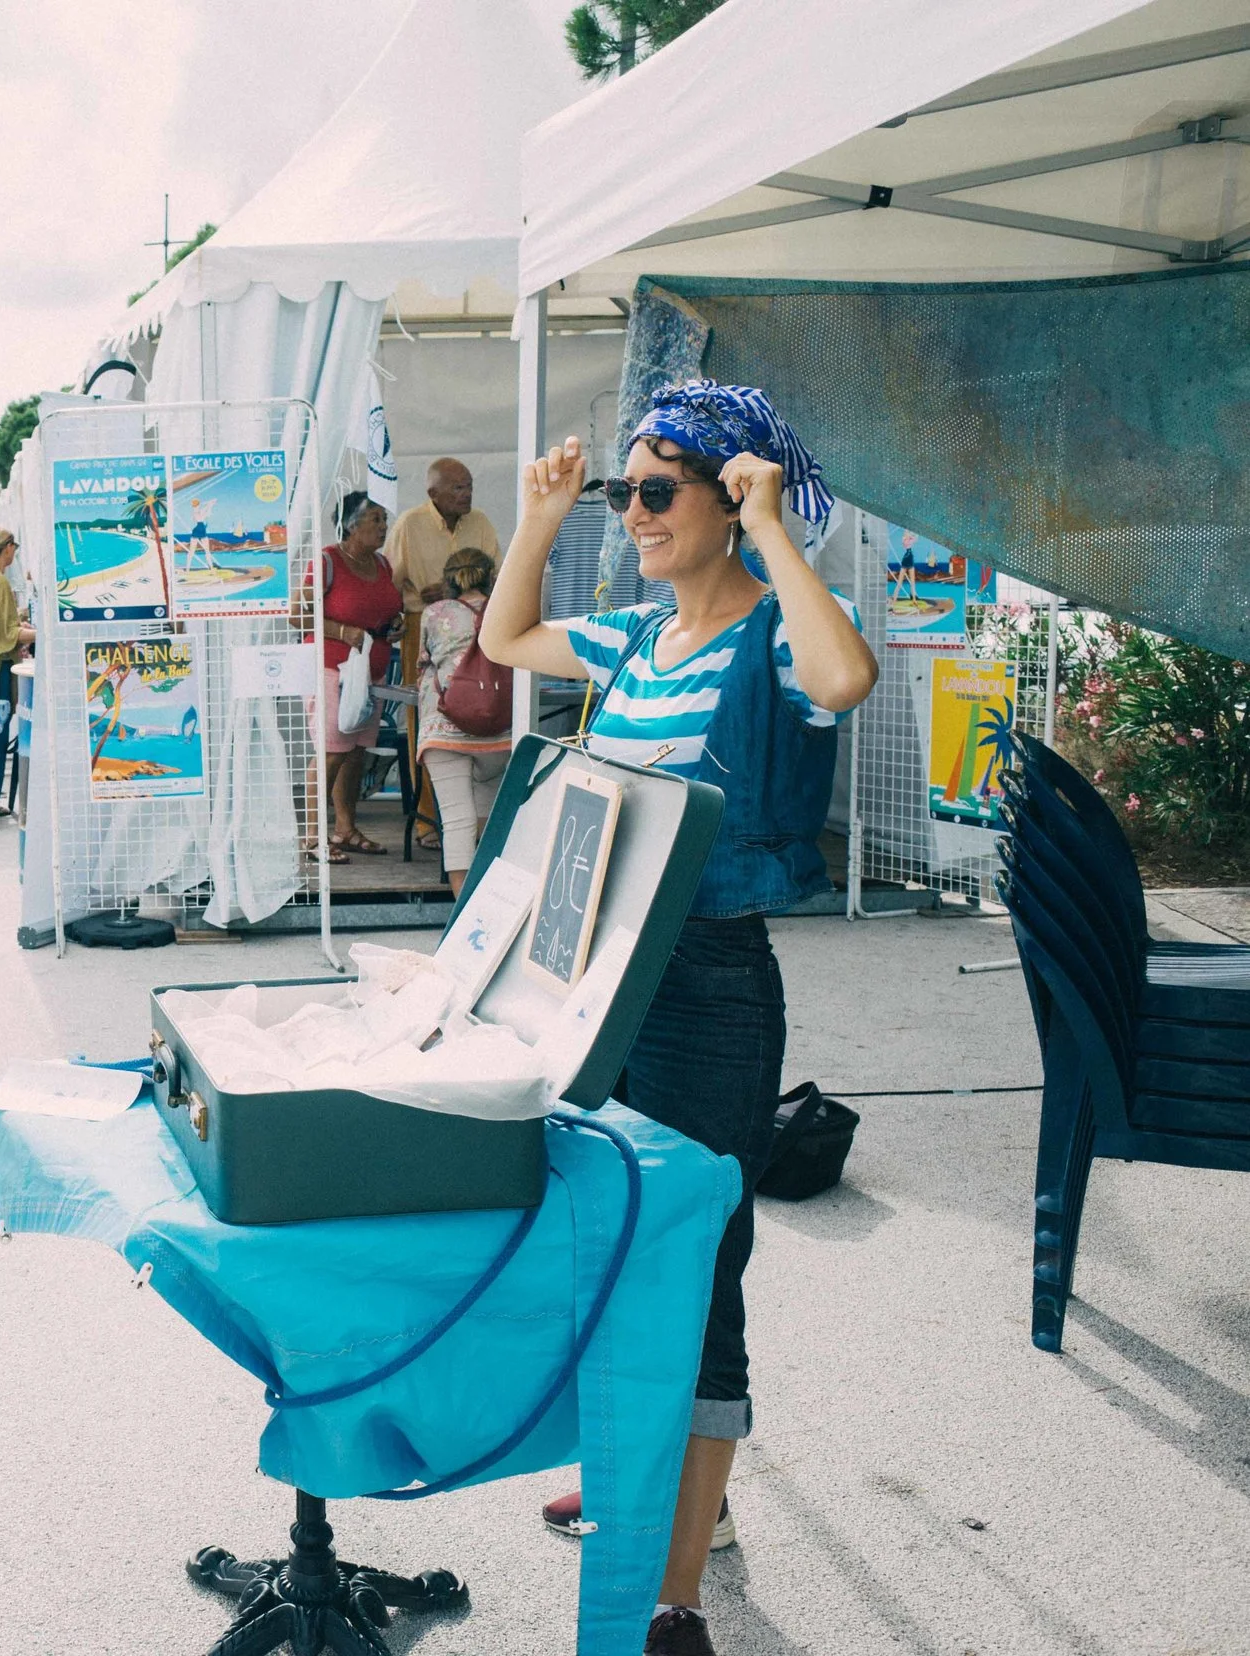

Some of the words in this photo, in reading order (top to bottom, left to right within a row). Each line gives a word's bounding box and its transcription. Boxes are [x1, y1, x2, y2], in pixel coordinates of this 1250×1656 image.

[224, 456, 243, 469] DES
[244, 453, 284, 468] VOILES
[59, 475, 160, 495] LAVANDOU
[86, 643, 192, 667] CHALLENGE
[141, 669, 151, 682] de
[154, 667, 166, 680] la
[166, 664, 192, 678] Baie
[941, 676, 1006, 696] LAVANDOU
